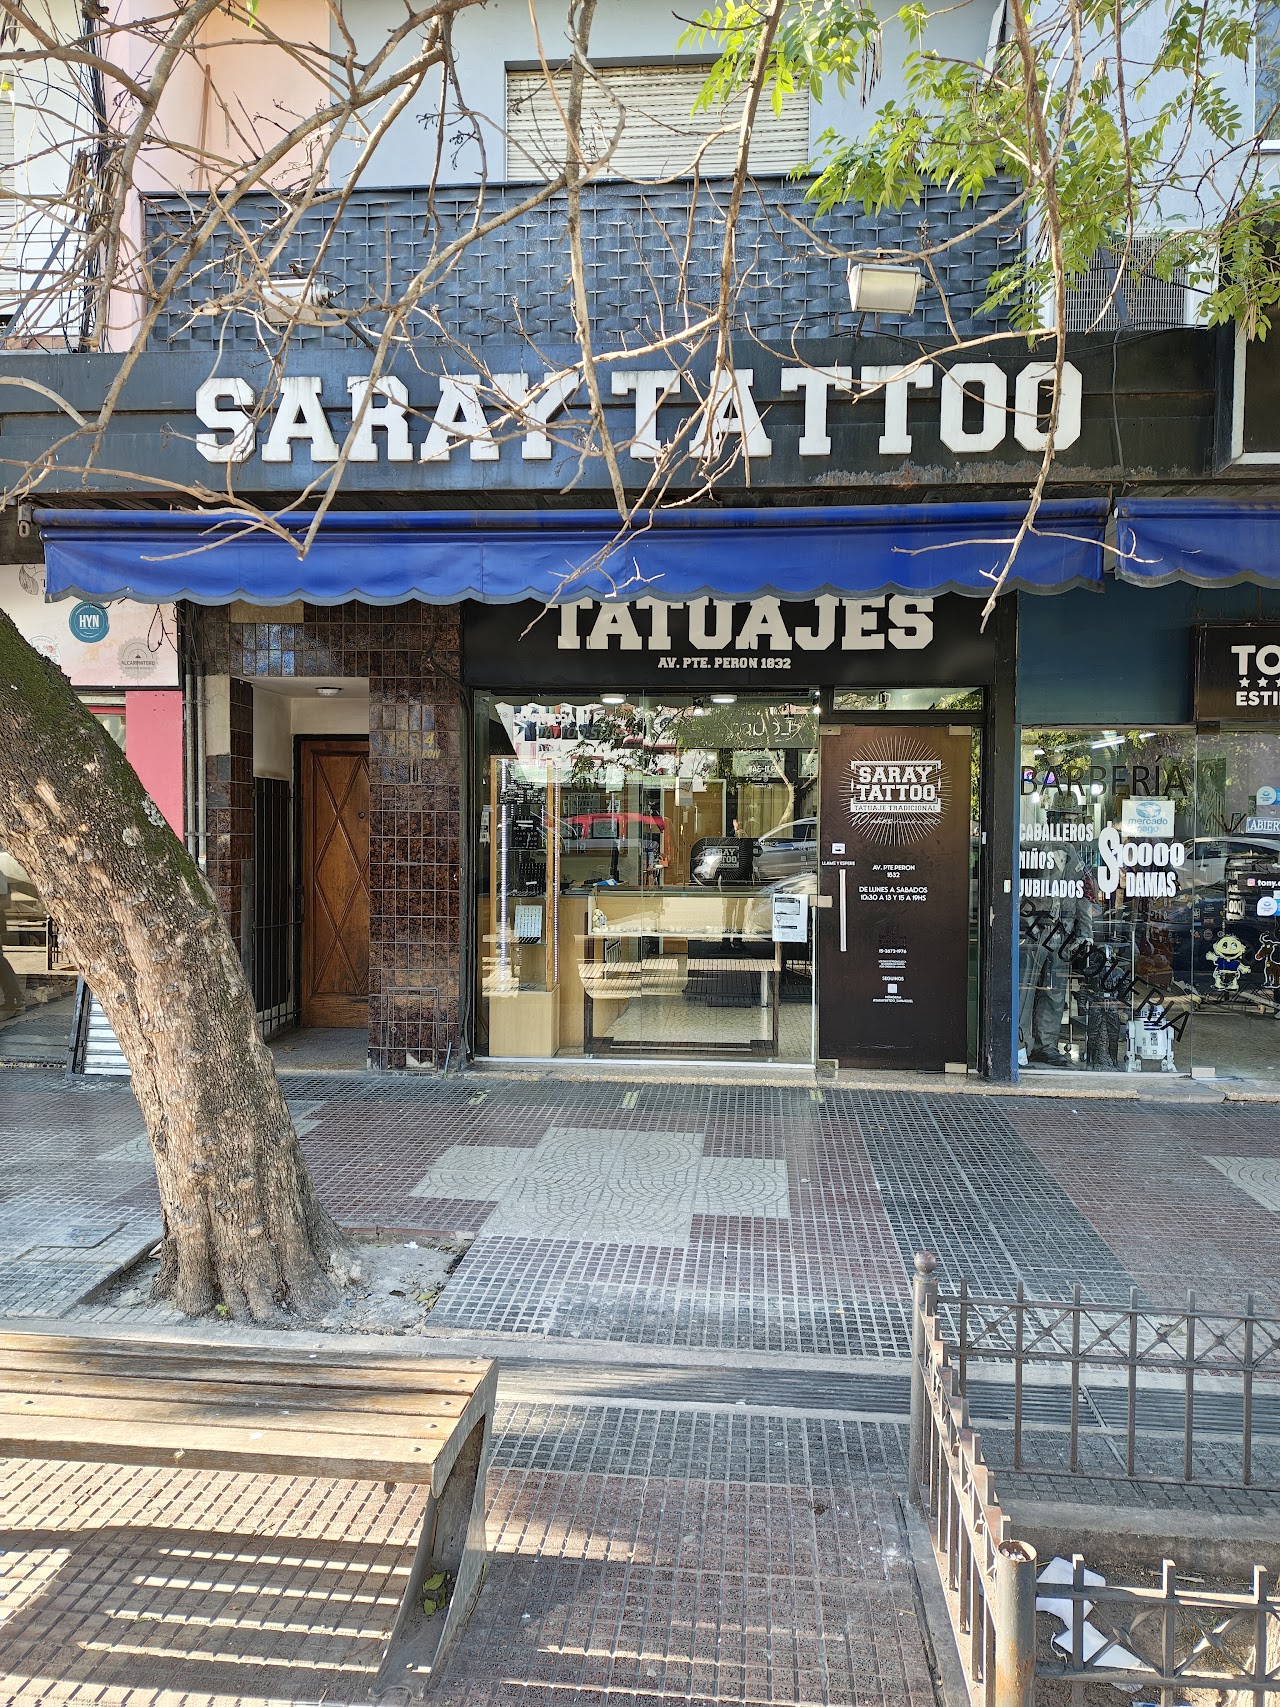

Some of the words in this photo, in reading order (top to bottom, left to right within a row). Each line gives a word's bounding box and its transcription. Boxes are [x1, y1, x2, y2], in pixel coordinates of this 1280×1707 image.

[196, 372, 579, 462] SARAY
[610, 361, 1083, 459] TATTOO
[79, 614, 100, 628] HYN
[548, 593, 934, 651] TATUAJES
[658, 657, 680, 669] AV.
[683, 657, 711, 669] PTE.
[714, 657, 758, 669] PERON
[761, 657, 791, 669] 1832
[1236, 690, 1280, 706] ESTI
[859, 766, 933, 783] SARAY
[1021, 755, 1188, 797] BARBERÍA
[856, 784, 936, 801] TATTOO
[1128, 817, 1168, 825] mercado
[1250, 820, 1280, 831] ABIER
[1019, 823, 1094, 842] CABALLEROS
[1019, 848, 1055, 870] NIÑOS
[1019, 879, 1085, 898] JUBILADOS
[1126, 872, 1177, 897] DAMAS
[1257, 879, 1280, 888] tony.
